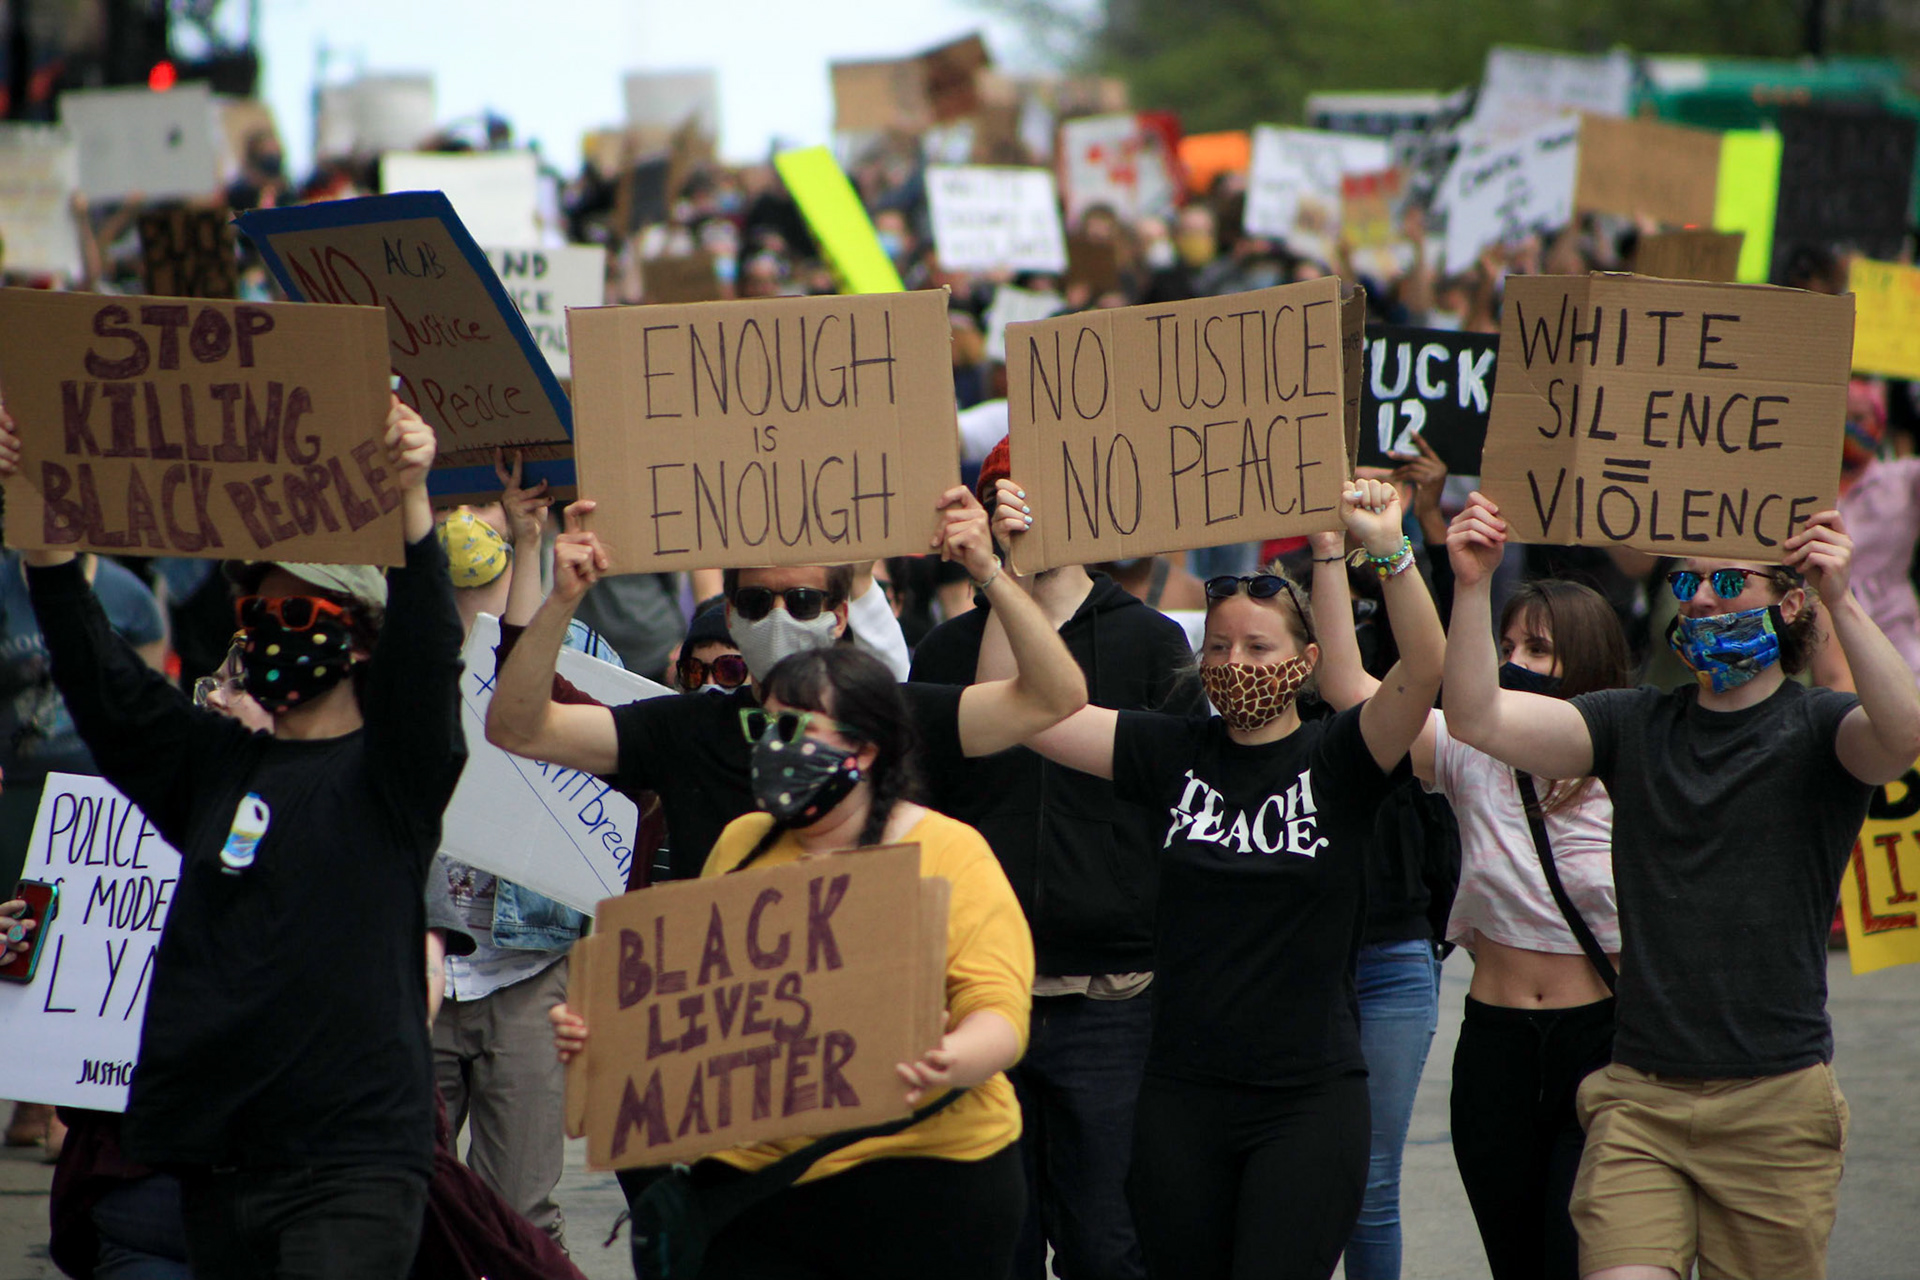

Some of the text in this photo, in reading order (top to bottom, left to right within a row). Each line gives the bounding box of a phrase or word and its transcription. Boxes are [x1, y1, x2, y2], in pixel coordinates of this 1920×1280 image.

[485, 249, 549, 279] ND
[84, 304, 275, 380] STOP
[386, 294, 491, 356] Justice
[1029, 326, 1109, 425] NO
[1139, 300, 1337, 413] JUSTICE
[1516, 293, 1742, 371] WHITE
[643, 310, 896, 420] ENOUGH
[1363, 336, 1497, 414] UCK
[61, 380, 322, 466] KILLING
[422, 378, 531, 435] Peace
[753, 425, 779, 453] IS
[1378, 398, 1427, 456] 12
[1537, 378, 1791, 453] SILENCE
[41, 439, 403, 553] BLACK PEOPLE
[646, 450, 896, 556] ENOUGH
[1062, 412, 1336, 542] NO PEACE
[1526, 467, 1819, 548] VIOLENCE
[46, 792, 156, 870] POLICE
[618, 873, 852, 1011] BLACK
[646, 971, 813, 1061] LIVES
[610, 1029, 861, 1160] MATTER
